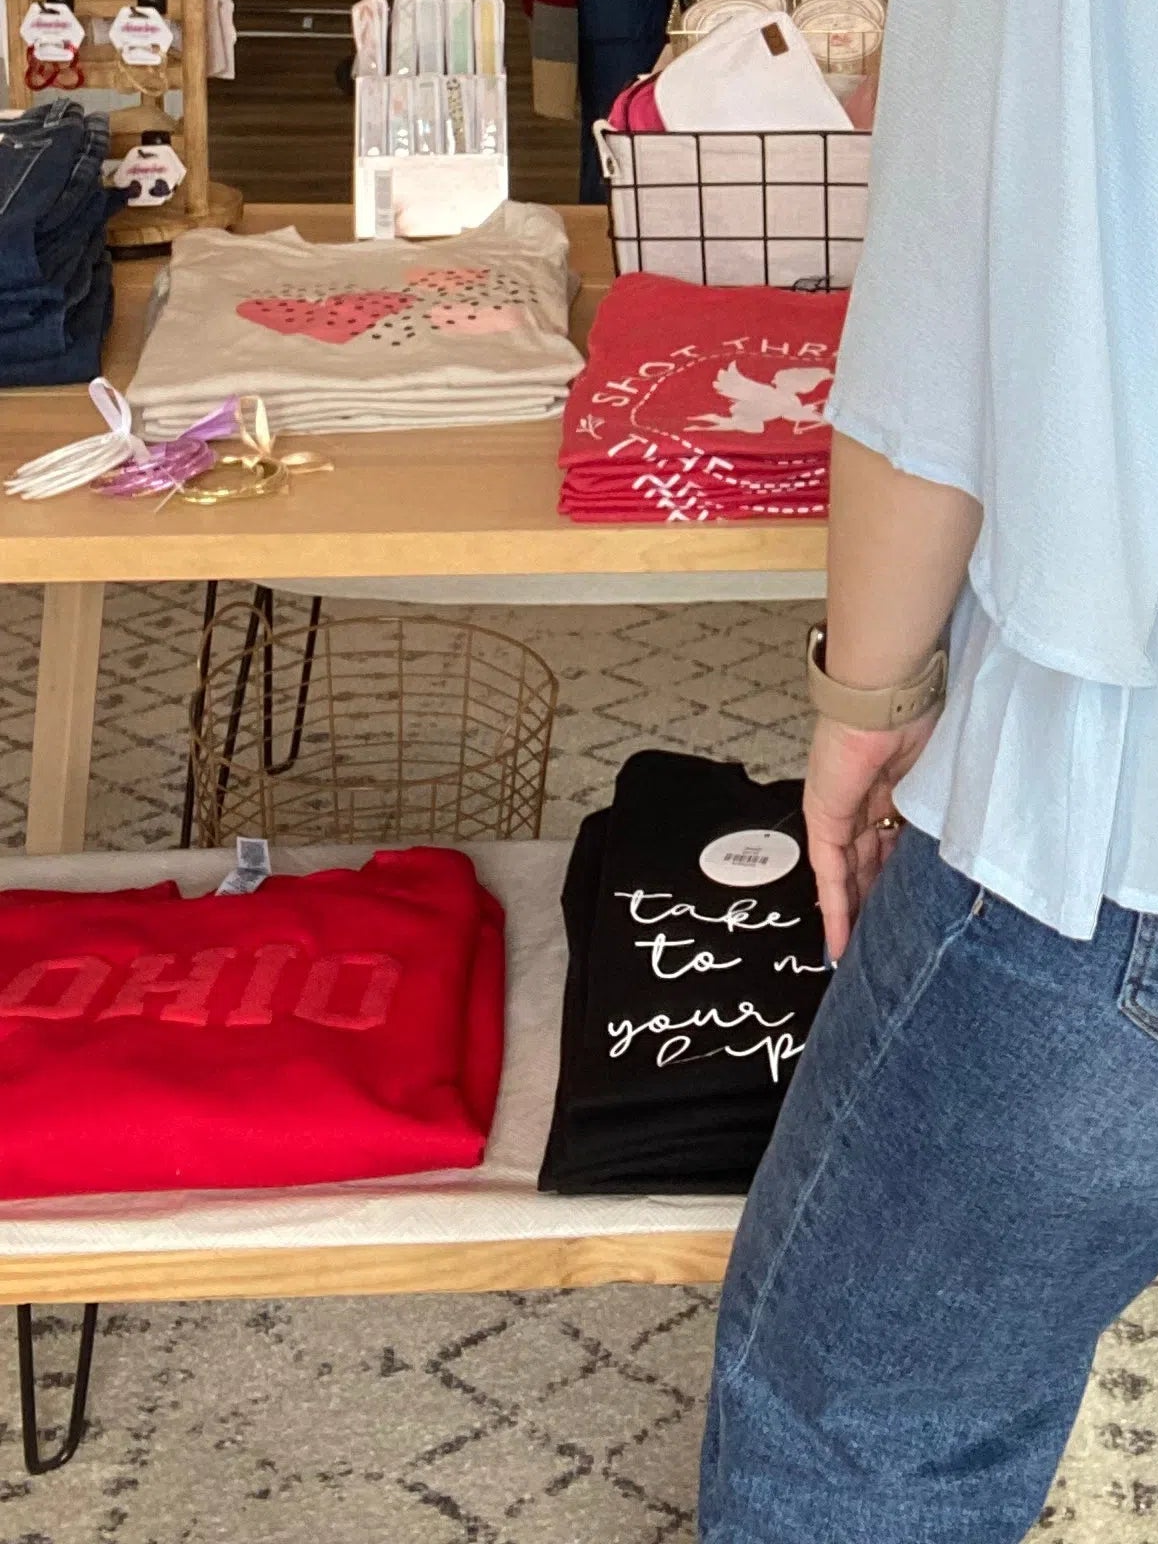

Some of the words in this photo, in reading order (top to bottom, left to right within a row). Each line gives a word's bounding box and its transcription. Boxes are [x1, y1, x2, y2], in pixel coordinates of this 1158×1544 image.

[591, 345, 698, 407] SHOT
[722, 337, 828, 357] THR
[613, 889, 801, 933] take
[634, 933, 743, 979] to
[0, 943, 401, 1031] OHIO
[607, 1001, 795, 1058] your
